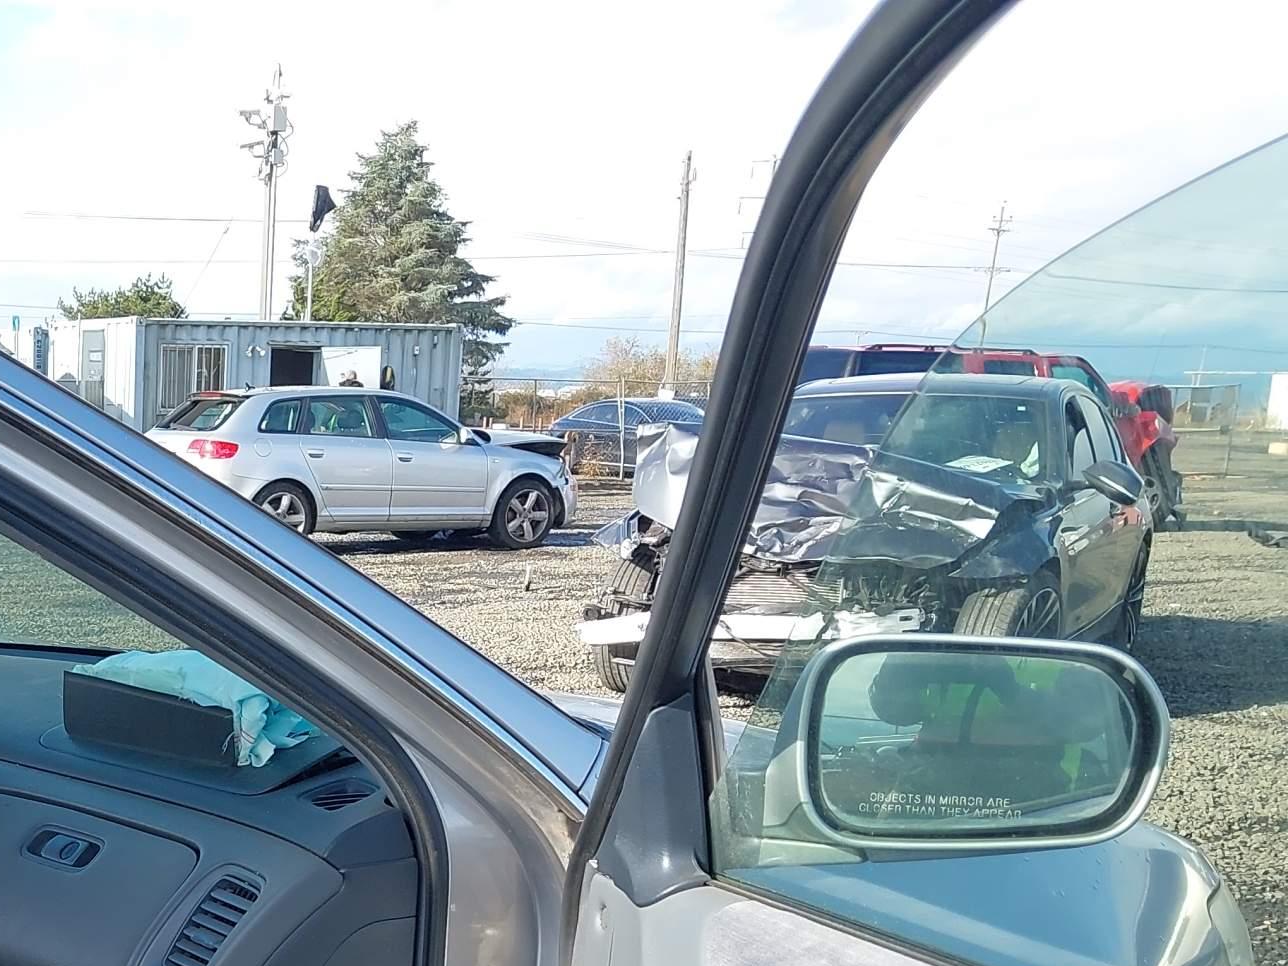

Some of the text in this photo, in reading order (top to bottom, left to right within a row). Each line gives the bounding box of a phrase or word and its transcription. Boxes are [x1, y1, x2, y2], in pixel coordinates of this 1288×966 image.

[870, 792, 1011, 808] OBJECTS IN MIRROR ARE
[905, 805, 936, 816] THAN
[940, 807, 970, 817] THEY
[973, 808, 1022, 820] APPEAR
